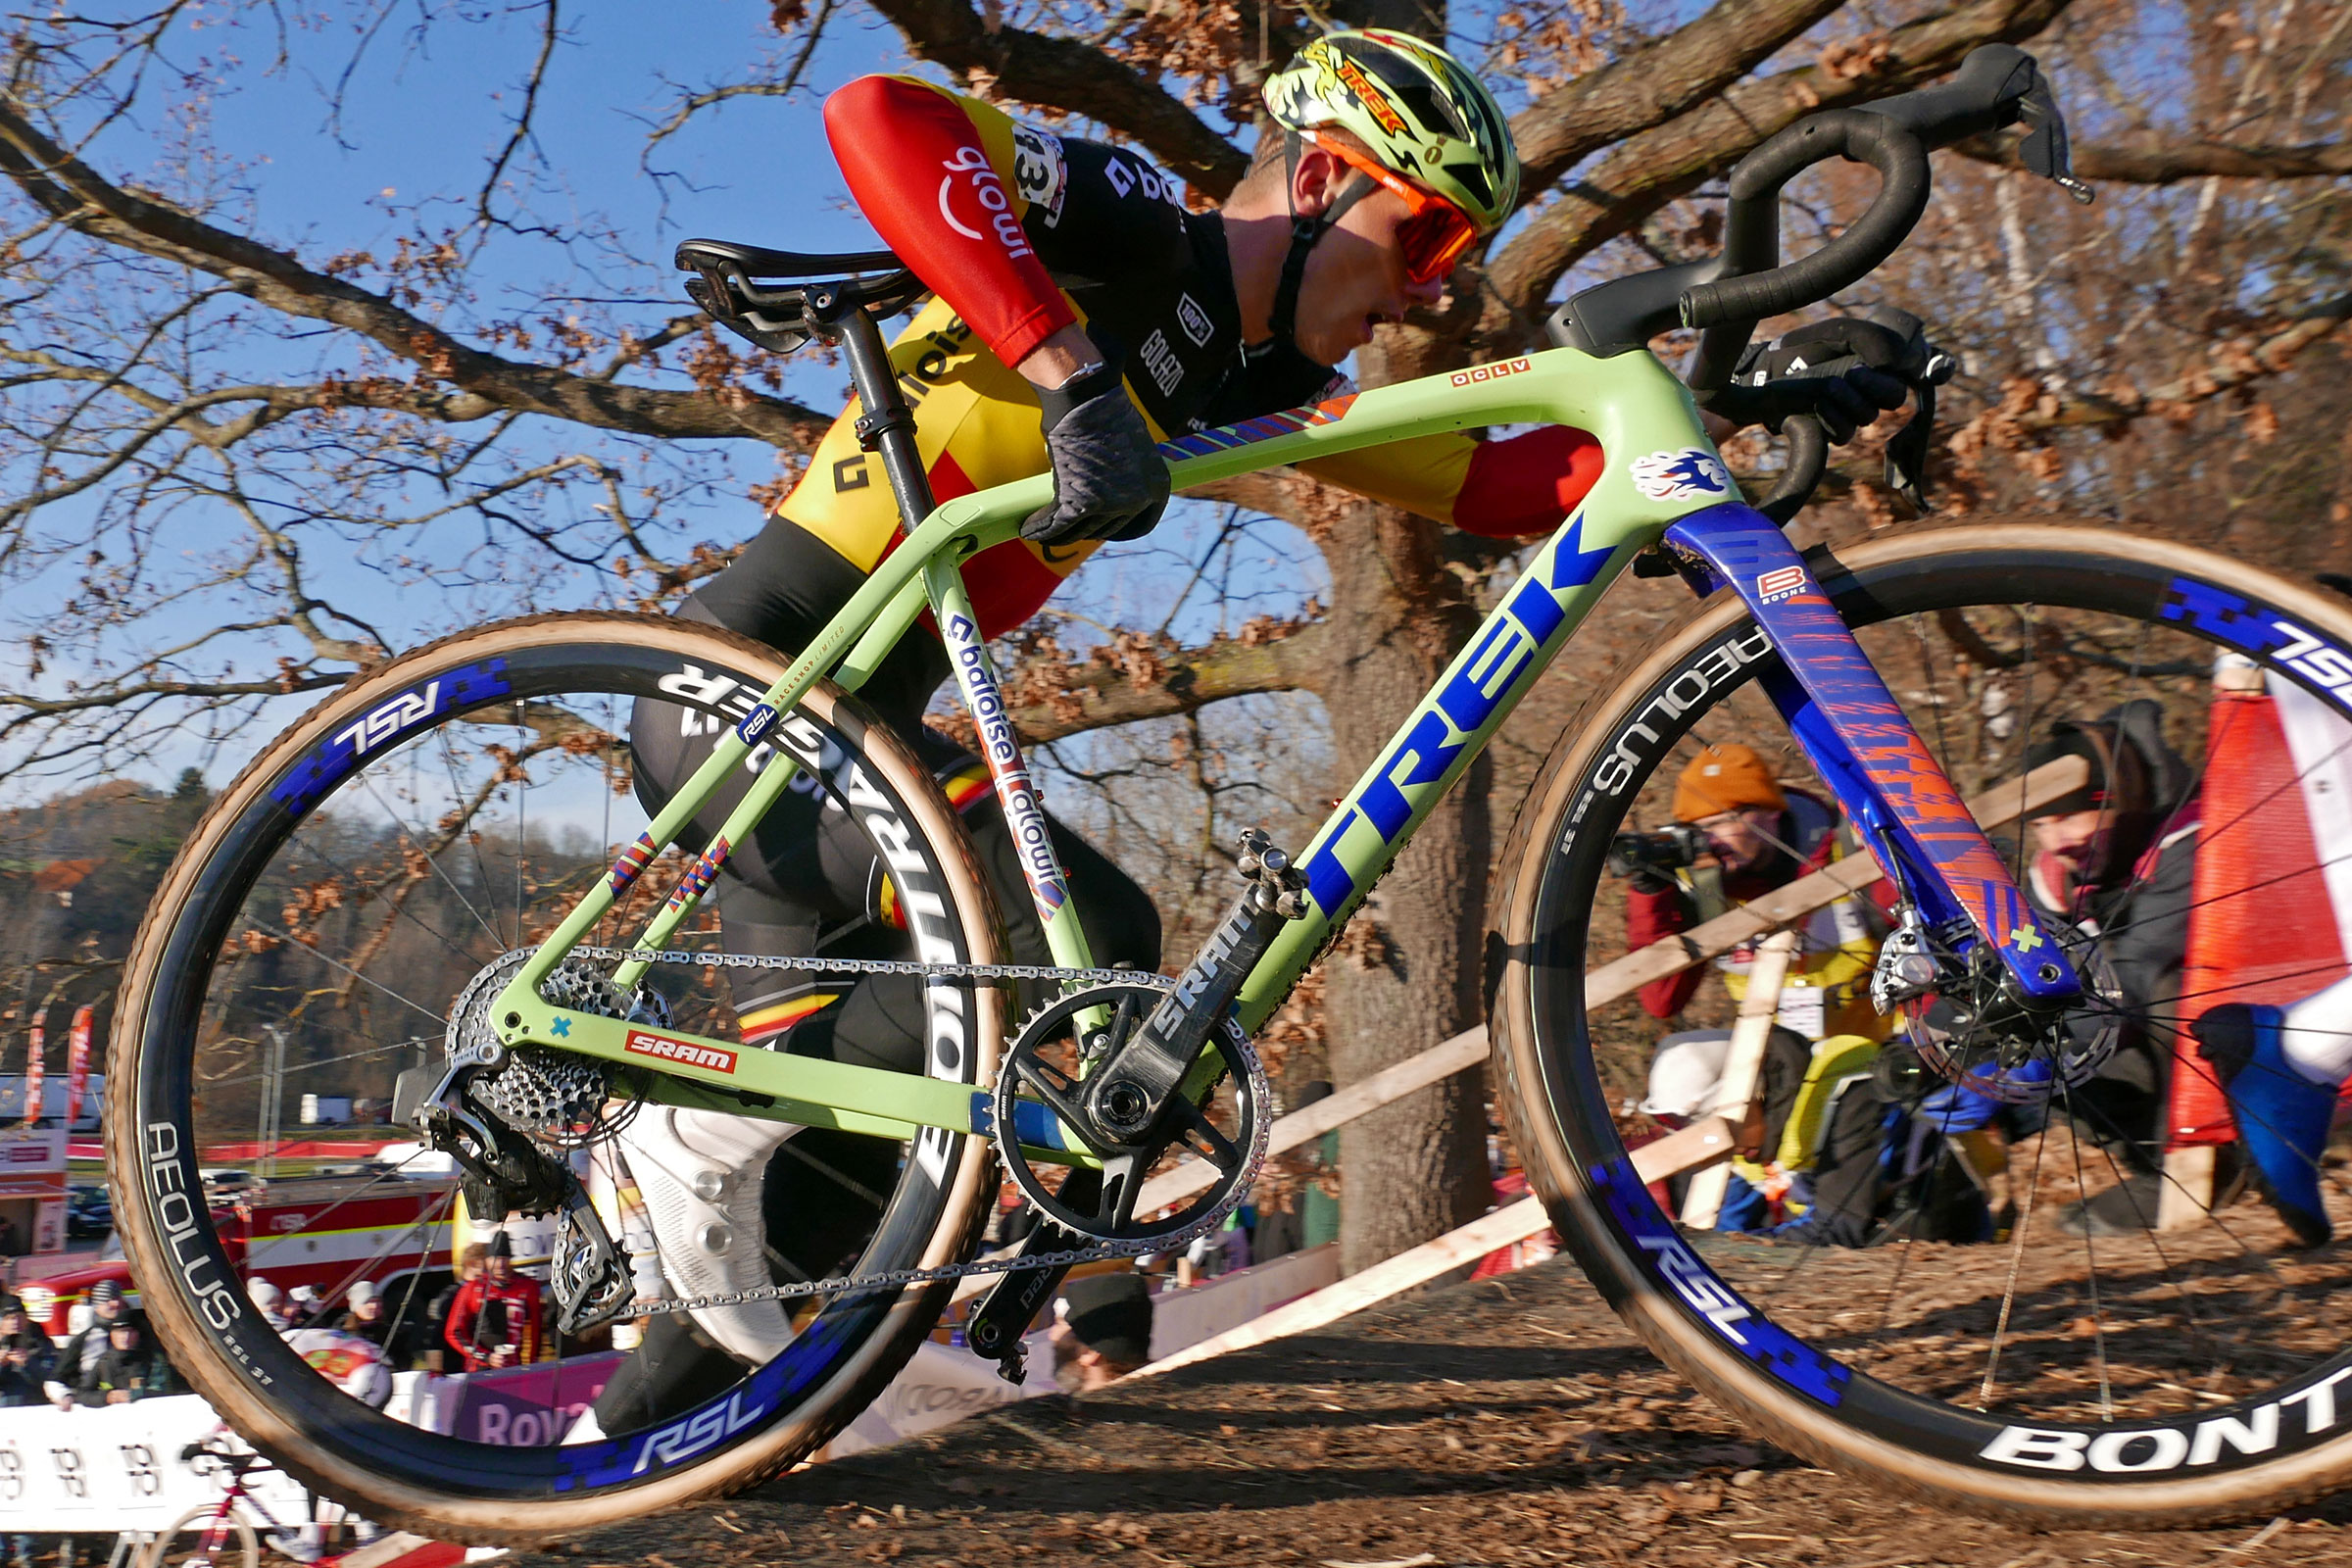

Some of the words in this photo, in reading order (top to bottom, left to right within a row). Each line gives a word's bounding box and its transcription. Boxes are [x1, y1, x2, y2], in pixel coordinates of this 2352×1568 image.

[1337, 60, 1408, 136] TREK
[942, 146, 1034, 259] glowi
[1181, 303, 1209, 339] 100%
[1140, 328, 1184, 398] GOLAZO
[1452, 359, 1529, 386] OCLV
[1762, 587, 1806, 605] BOONE
[773, 683, 795, 706] RACE
[794, 660, 814, 683] SHOP
[814, 625, 845, 661] LIMITED
[958, 645, 1014, 760] baloise
[2270, 620, 2352, 713] SL
[333, 681, 440, 756] RSL
[742, 708, 775, 743] RSL
[1304, 510, 1619, 921] TREK
[1592, 625, 1774, 796] AEOLUS
[1153, 904, 1260, 1042] SRAM
[629, 1035, 731, 1069] SRAM
[148, 1121, 241, 1330] AEOLUS
[1634, 1235, 1752, 1346] RSL
[221, 1334, 252, 1365] RSL
[251, 1365, 274, 1387] 37
[632, 1391, 765, 1475] RSL
